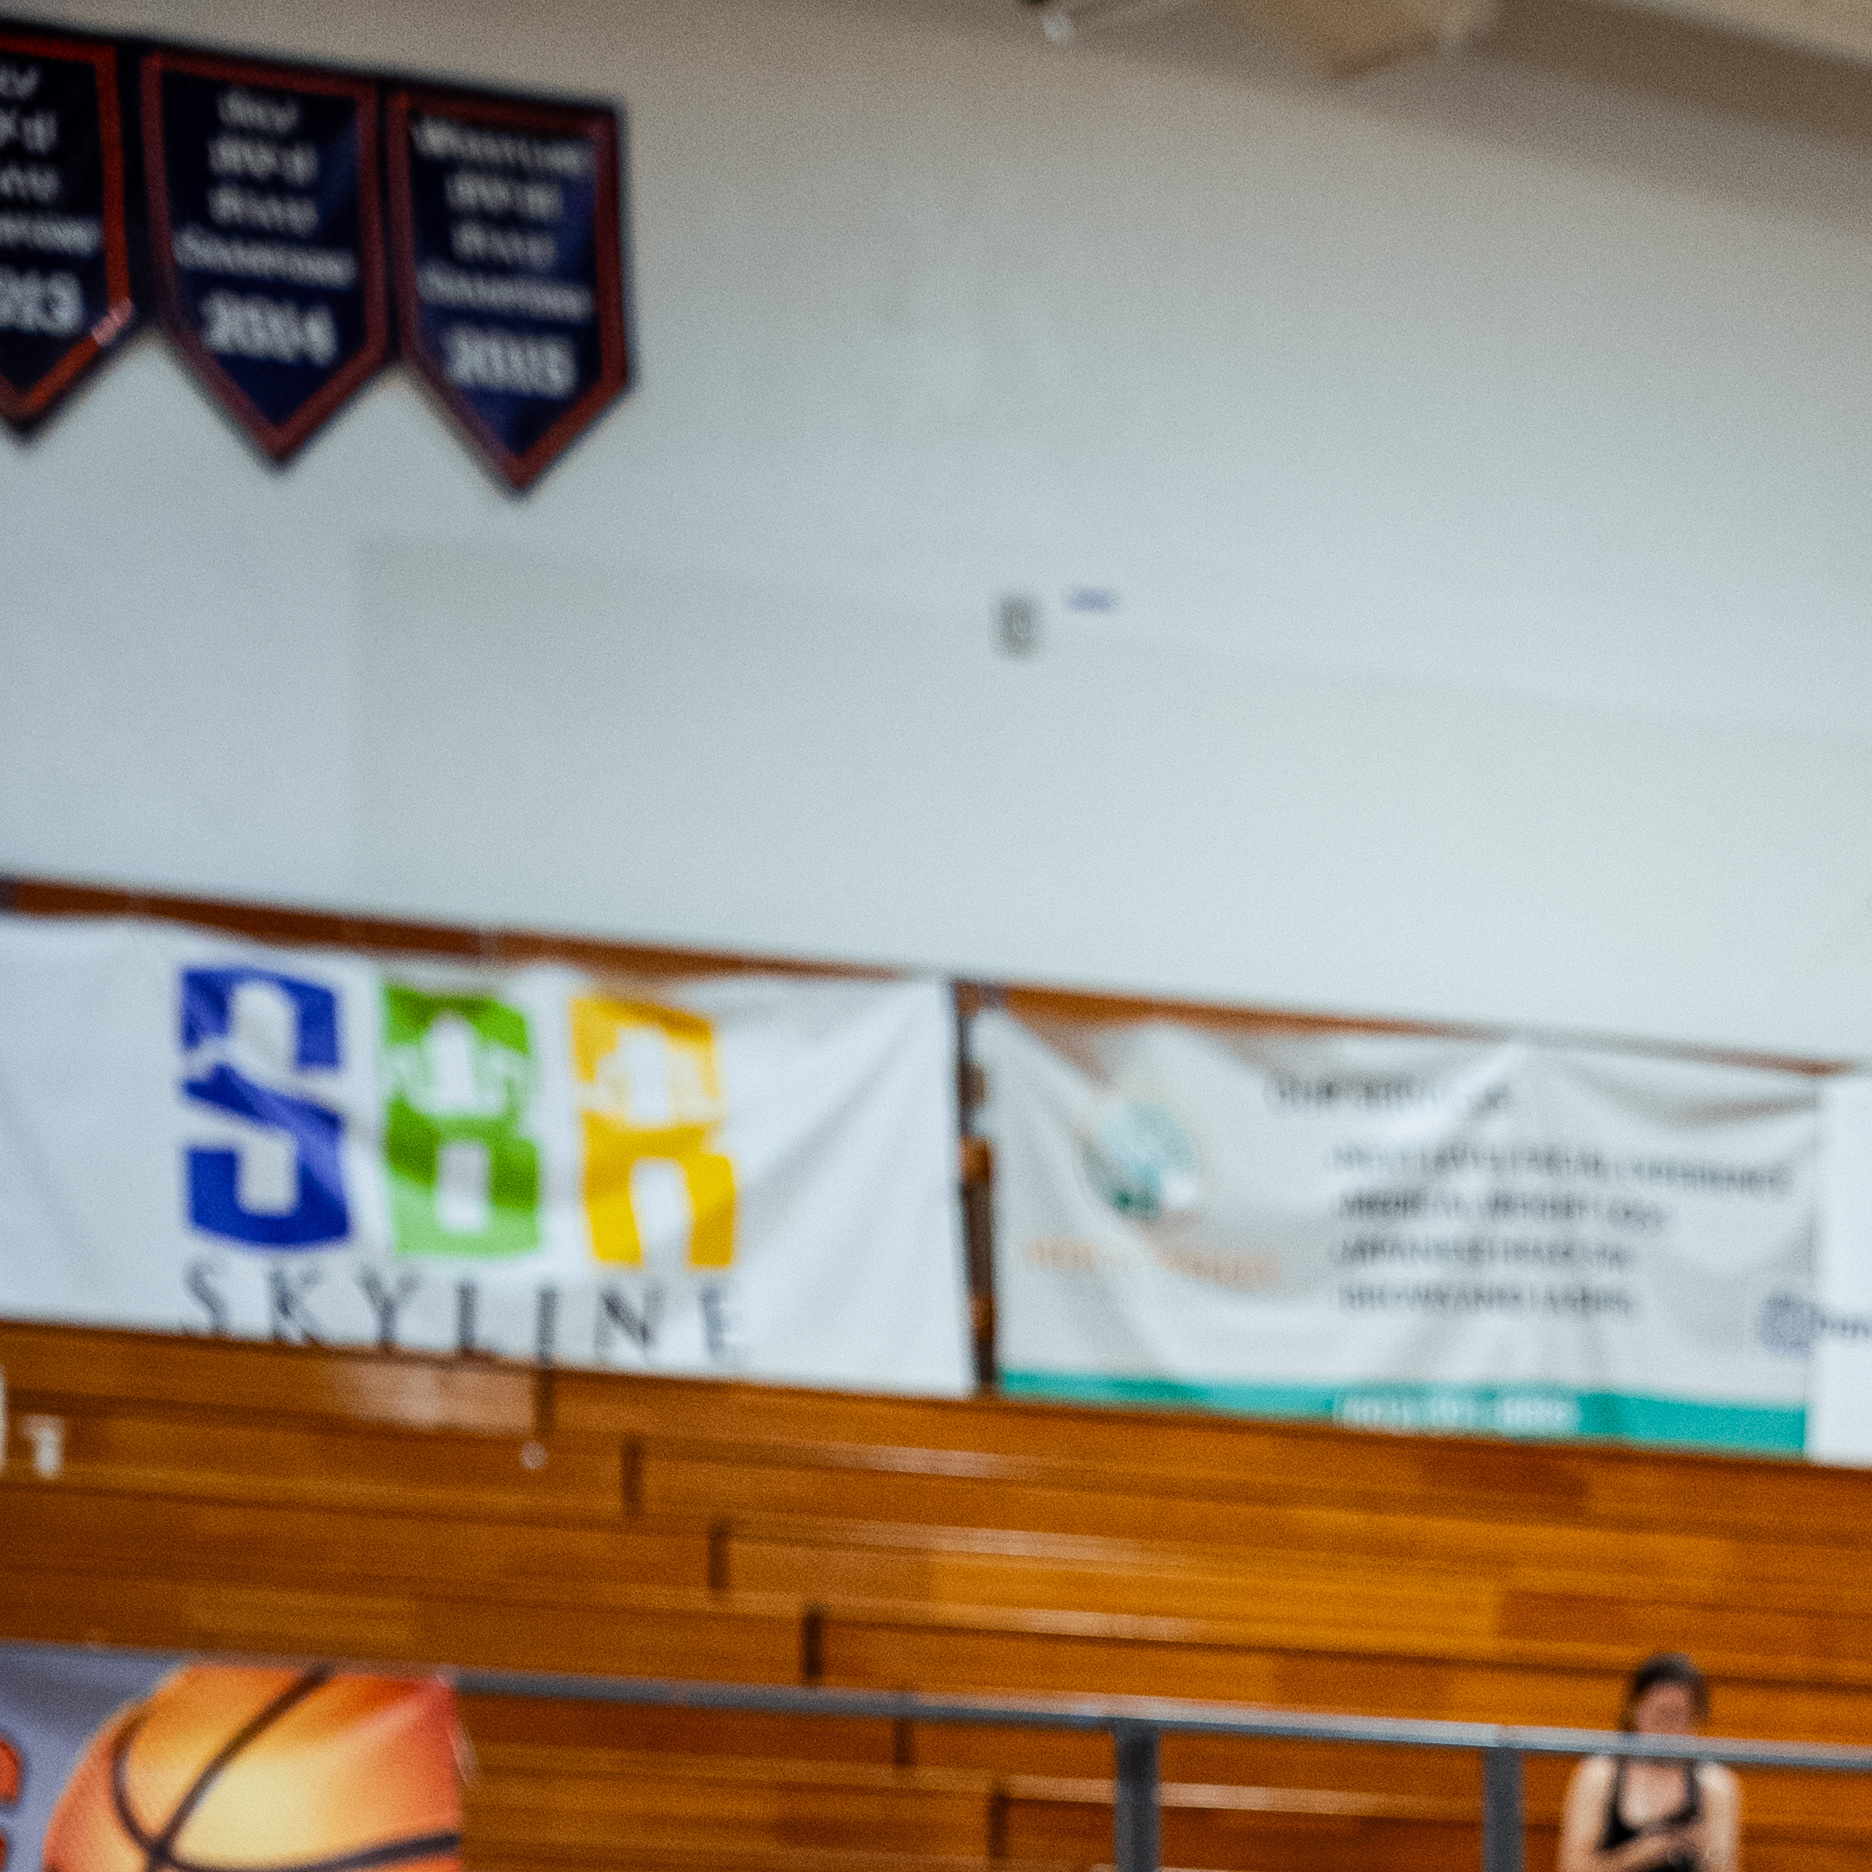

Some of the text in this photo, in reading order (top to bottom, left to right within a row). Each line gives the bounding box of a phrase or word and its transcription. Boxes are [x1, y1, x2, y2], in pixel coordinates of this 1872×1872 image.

[200, 290, 338, 368] 2014
[443, 325, 579, 398] 2015
[182, 1260, 744, 1366] SKYLINE
